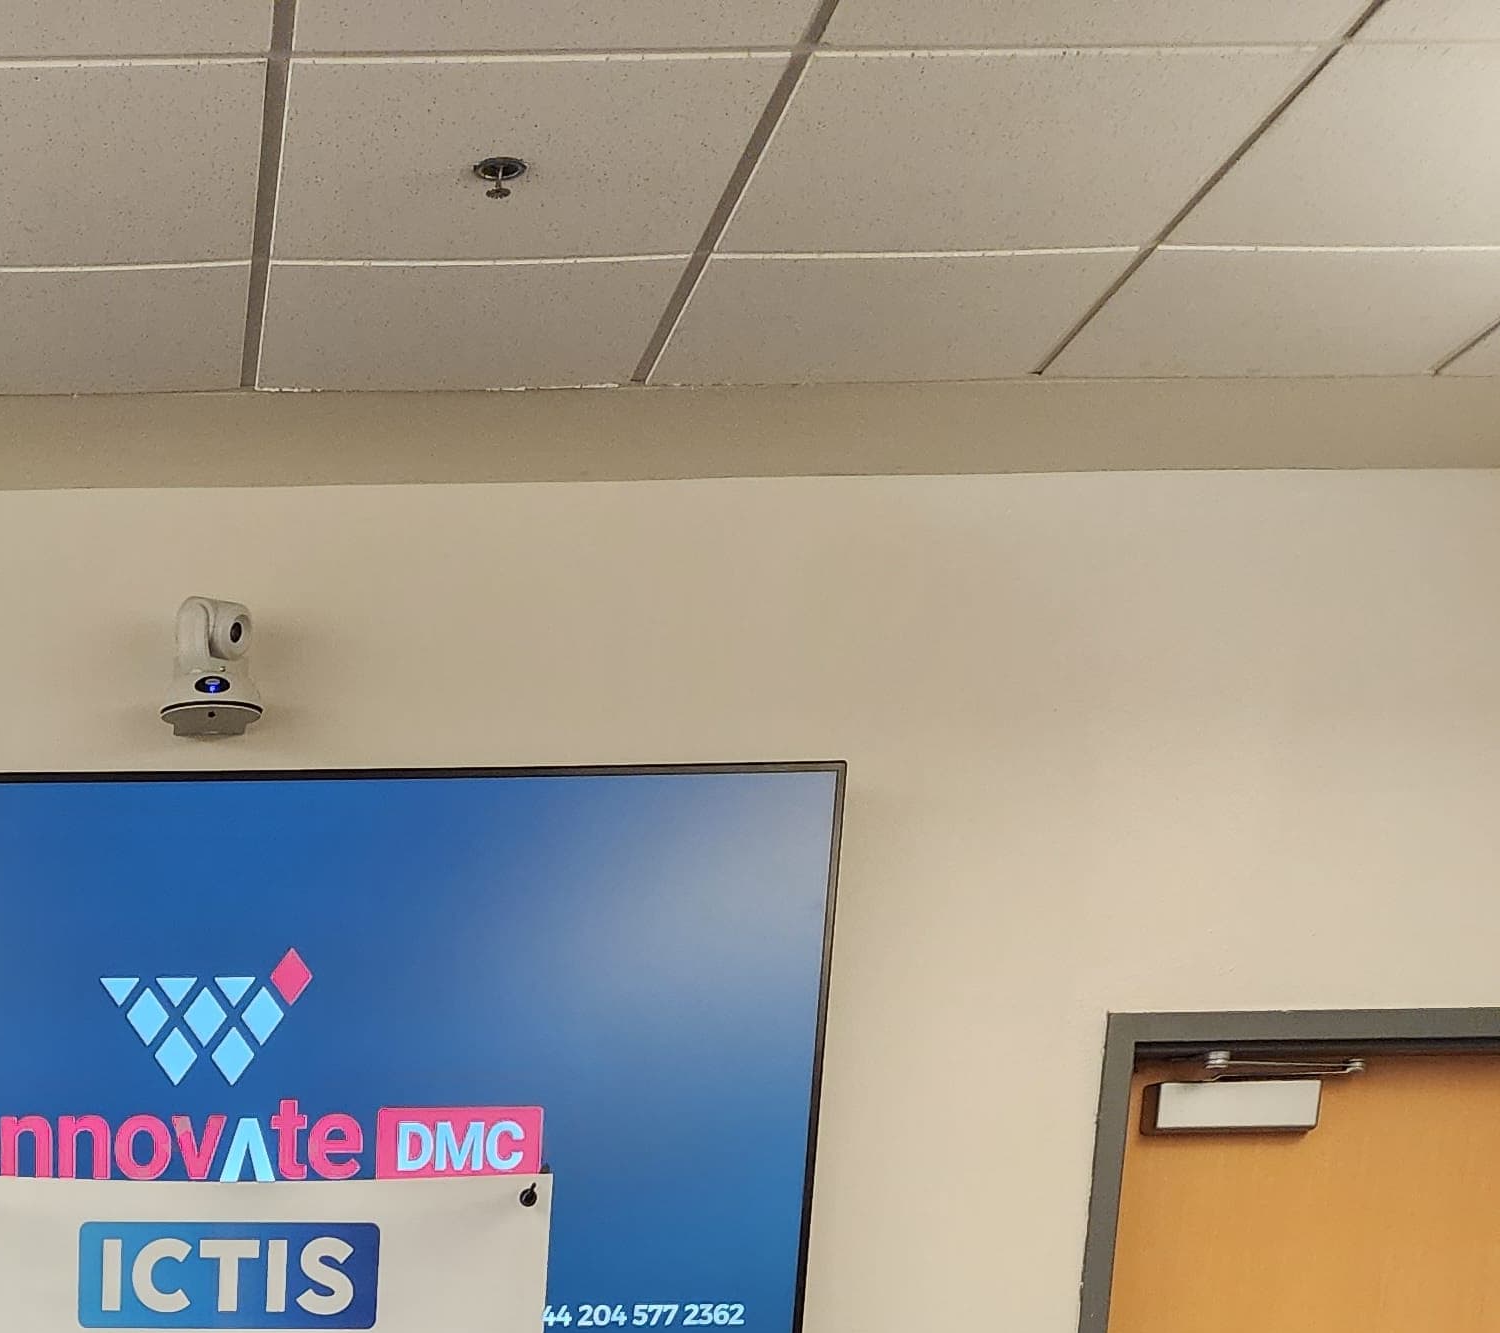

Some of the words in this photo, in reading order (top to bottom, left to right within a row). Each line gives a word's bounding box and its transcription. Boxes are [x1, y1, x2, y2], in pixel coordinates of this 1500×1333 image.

[396, 1118, 524, 1172] DMC
[100, 1235, 355, 1316] ICTIS
[577, 1304, 627, 1327] 204
[632, 1304, 678, 1326] 577
[683, 1303, 744, 1326] 2362
